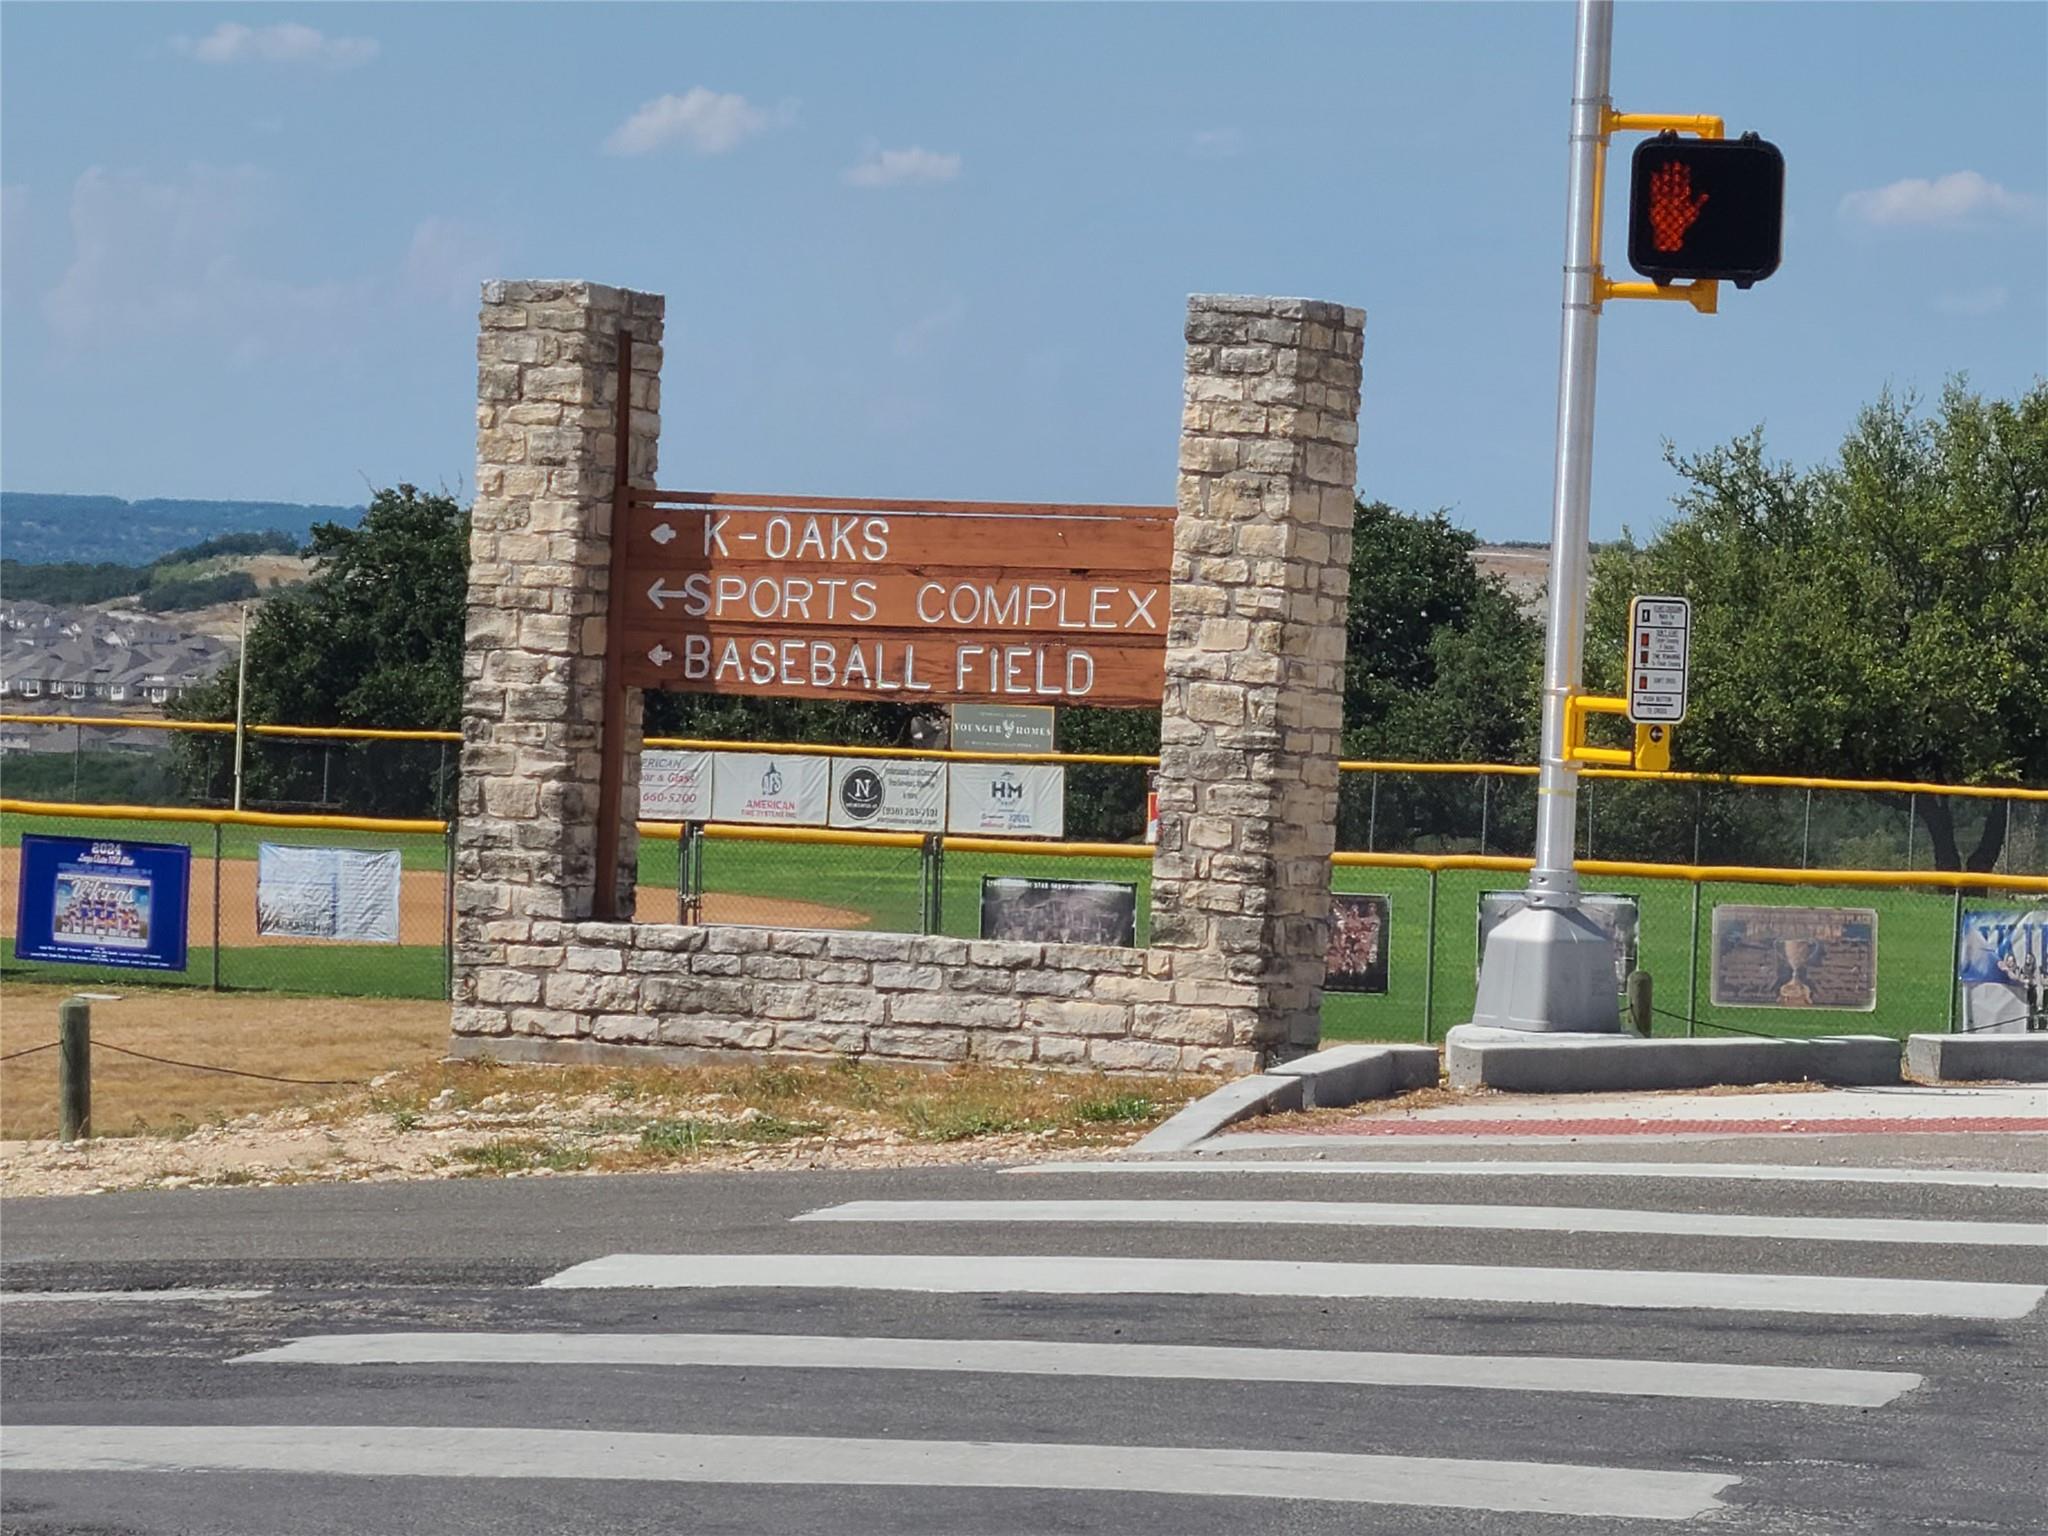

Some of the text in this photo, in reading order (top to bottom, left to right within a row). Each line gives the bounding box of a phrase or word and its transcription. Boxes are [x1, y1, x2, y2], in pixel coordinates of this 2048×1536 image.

[703, 513, 890, 562] K-OAKS
[683, 573, 1158, 630] SPORTS COMPLEX
[684, 634, 1095, 696] BASEBALL FIELD
[954, 723, 1052, 737] YOUNGER HOMES
[854, 778, 871, 798] N
[992, 780, 1023, 798] HM
[745, 799, 796, 811] AMERICAN
[91, 842, 122, 855] 2024
[71, 879, 135, 905] Vikings
